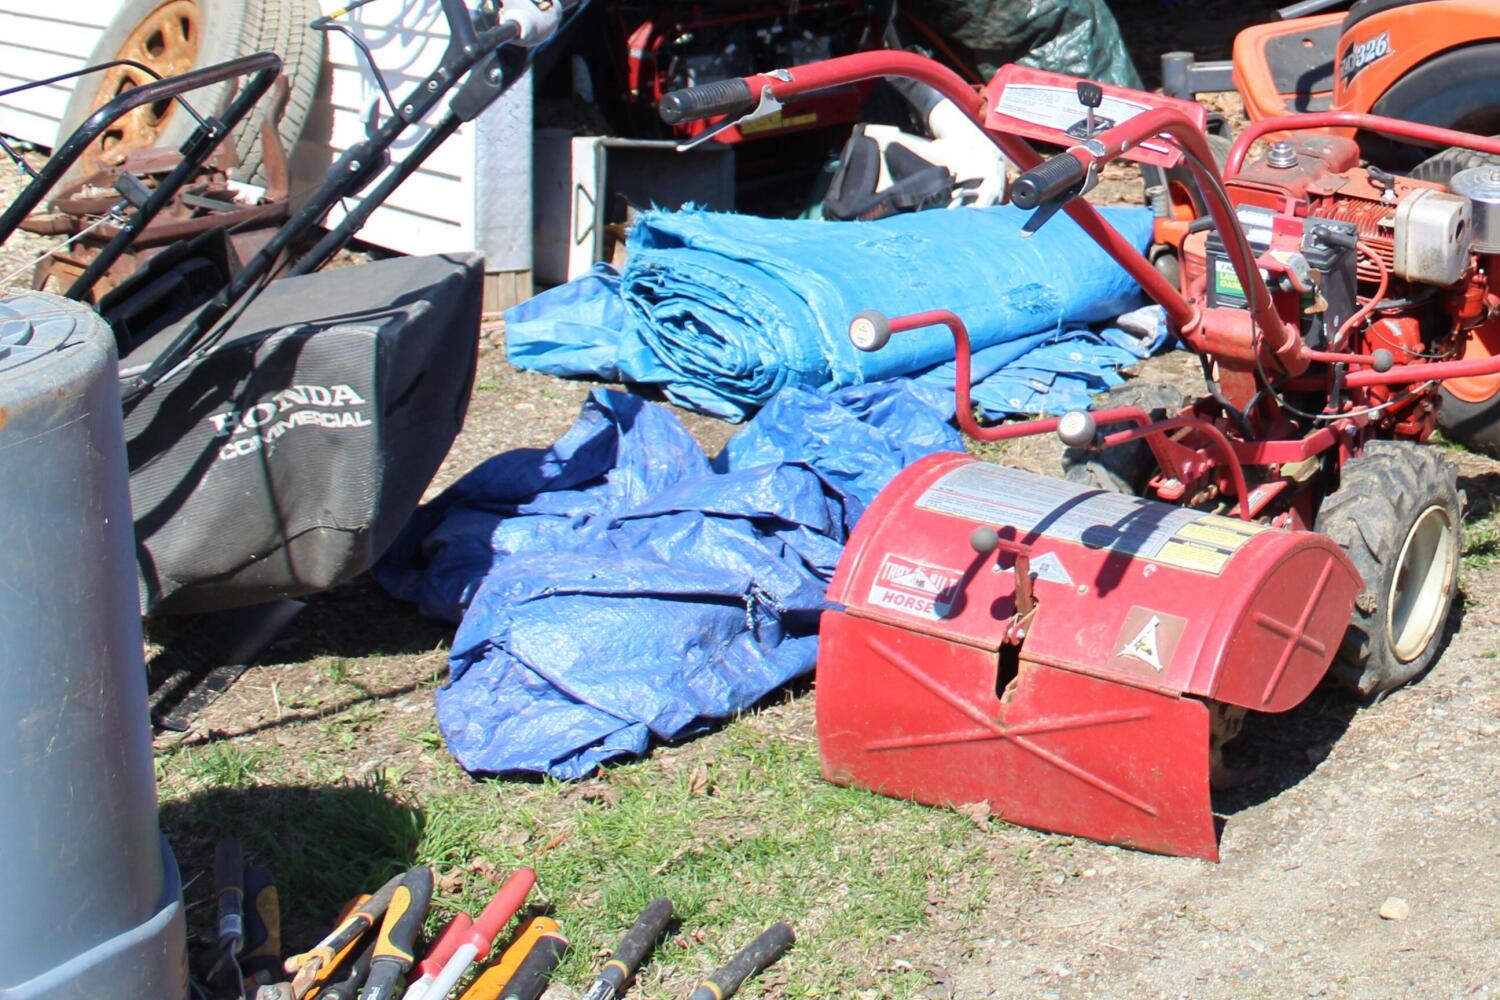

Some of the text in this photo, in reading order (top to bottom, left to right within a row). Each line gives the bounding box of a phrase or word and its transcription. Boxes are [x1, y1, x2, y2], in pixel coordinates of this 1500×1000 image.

[208, 384, 366, 437] HONDA
[218, 410, 372, 461] COMMERCIAL
[881, 590, 935, 614] HORSE
